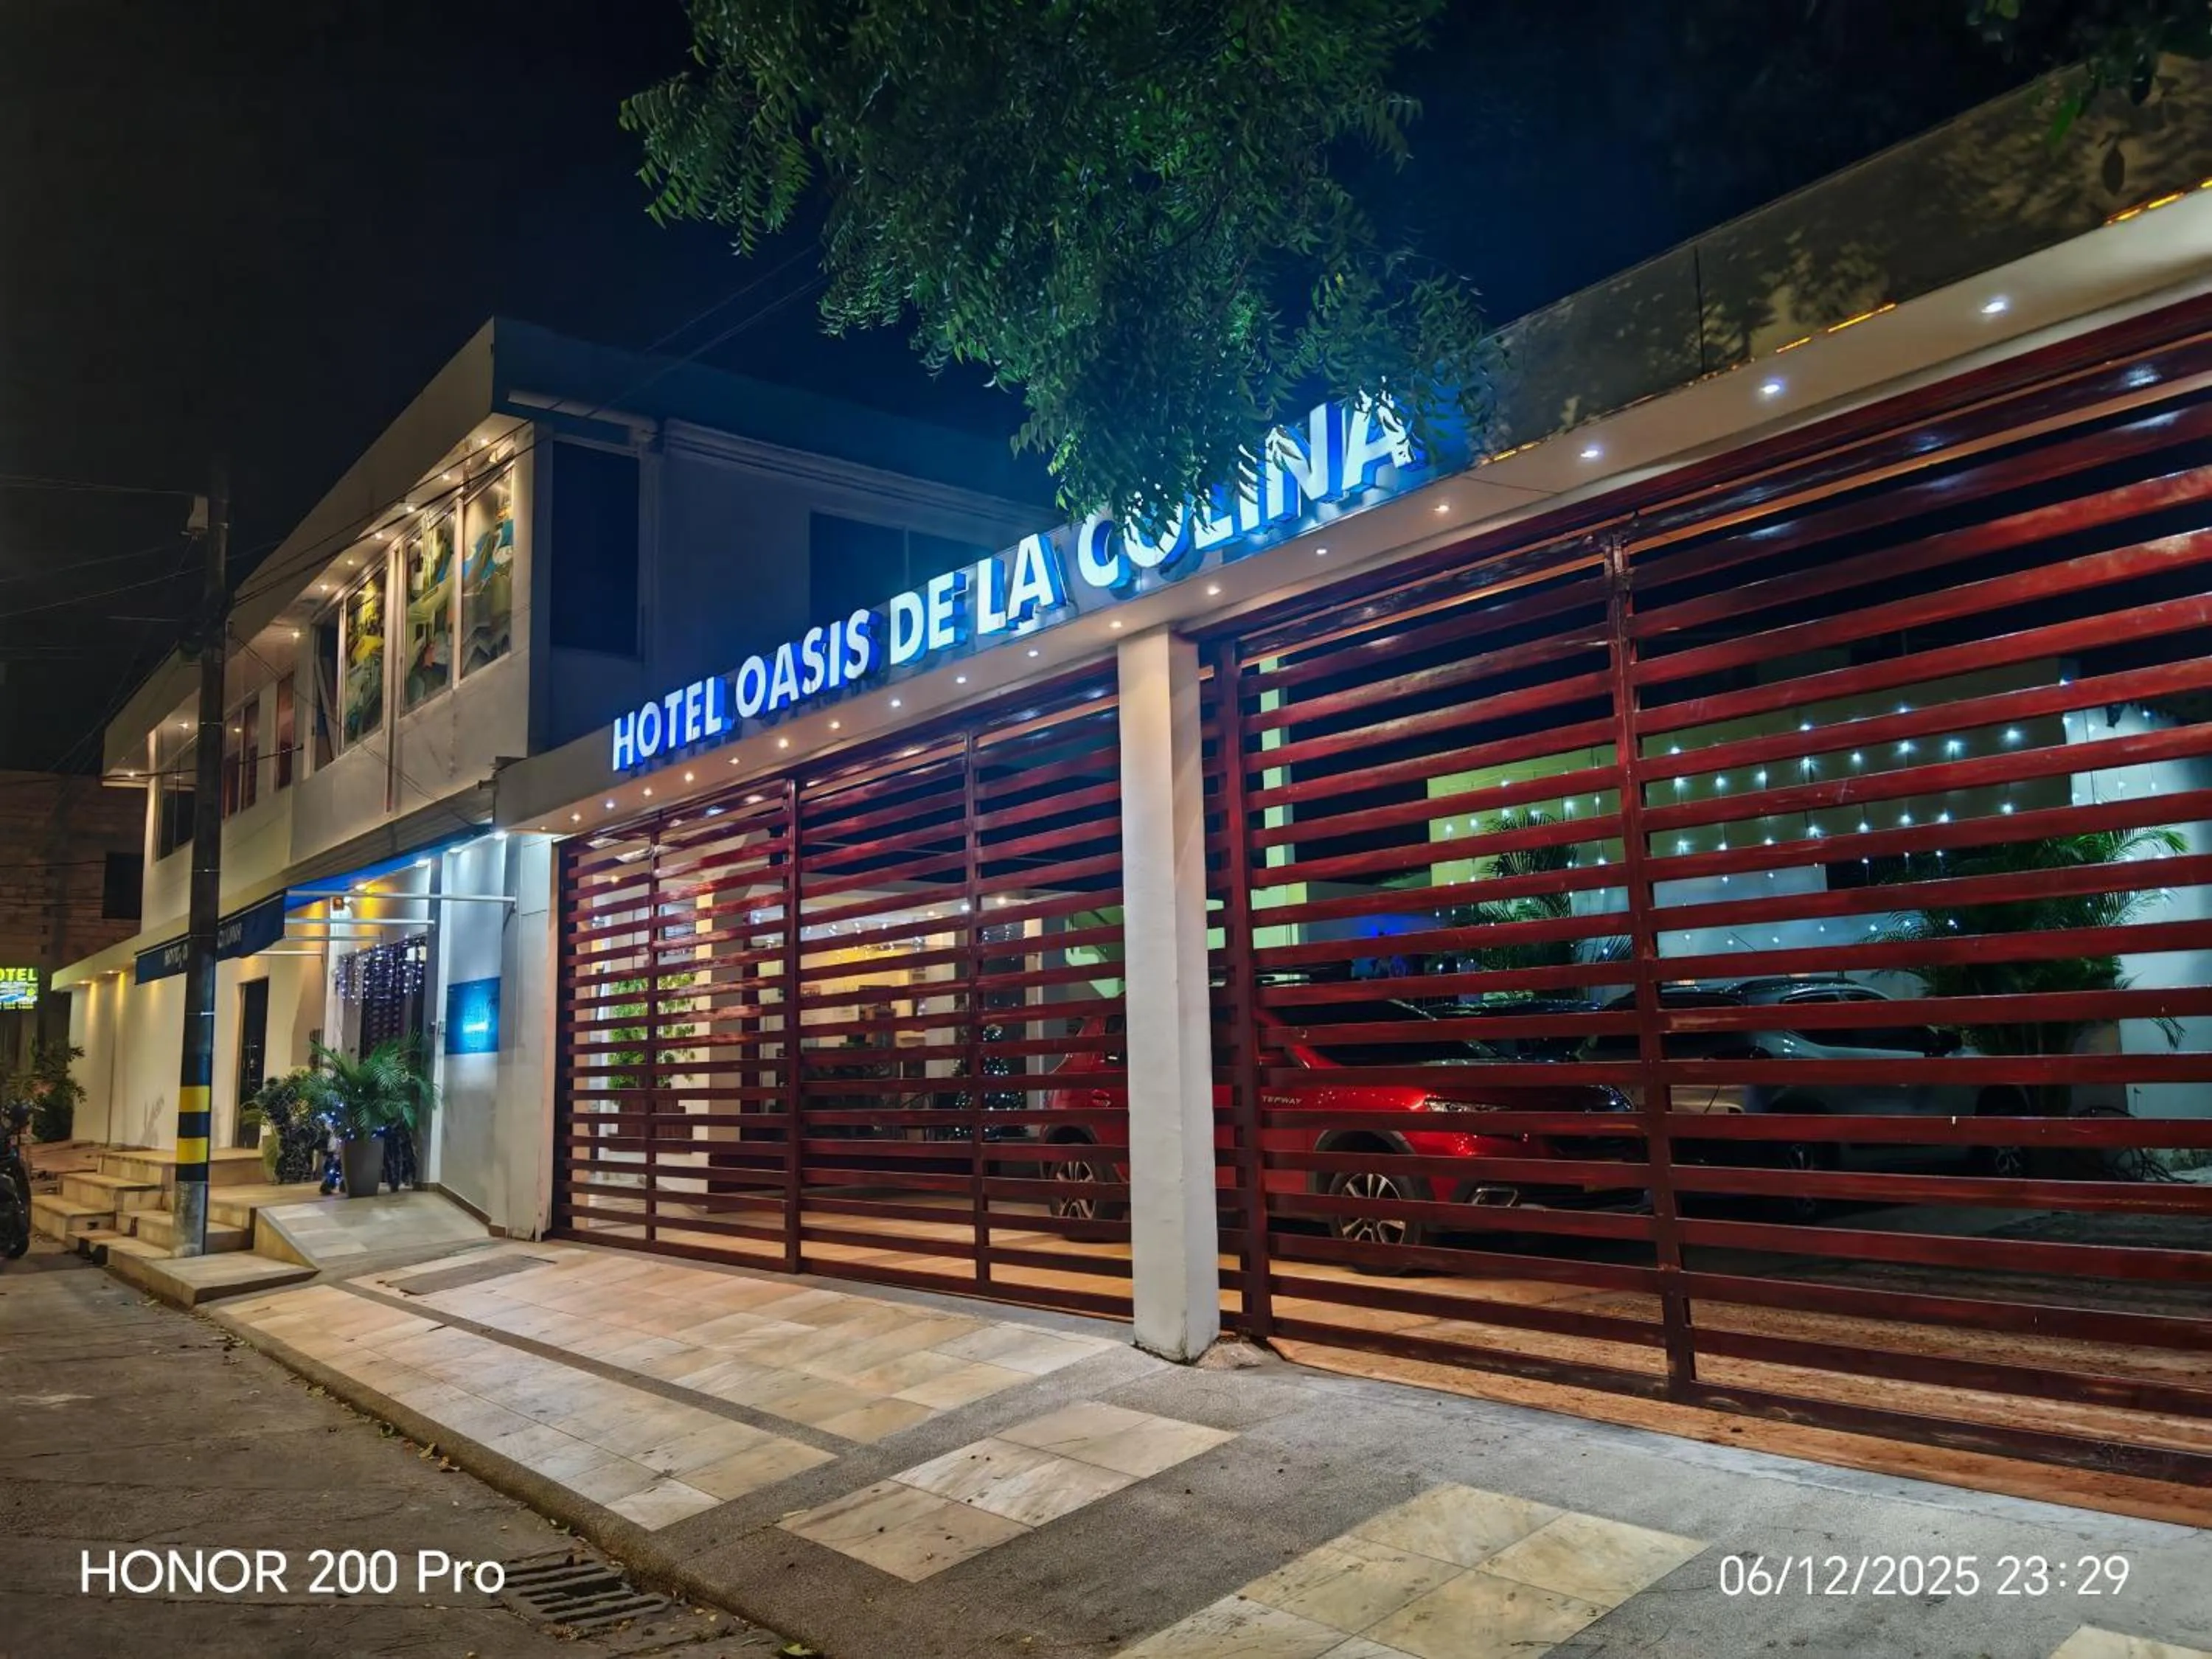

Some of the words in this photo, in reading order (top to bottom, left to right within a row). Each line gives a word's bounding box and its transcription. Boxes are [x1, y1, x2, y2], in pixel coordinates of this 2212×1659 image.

[613, 676, 726, 772] HOTEL
[735, 608, 873, 718] OASIS
[889, 571, 957, 665] DE
[977, 532, 1056, 636] LA
[0, 967, 38, 981] OTEL
[1262, 1095, 1303, 1105] TEPWAY
